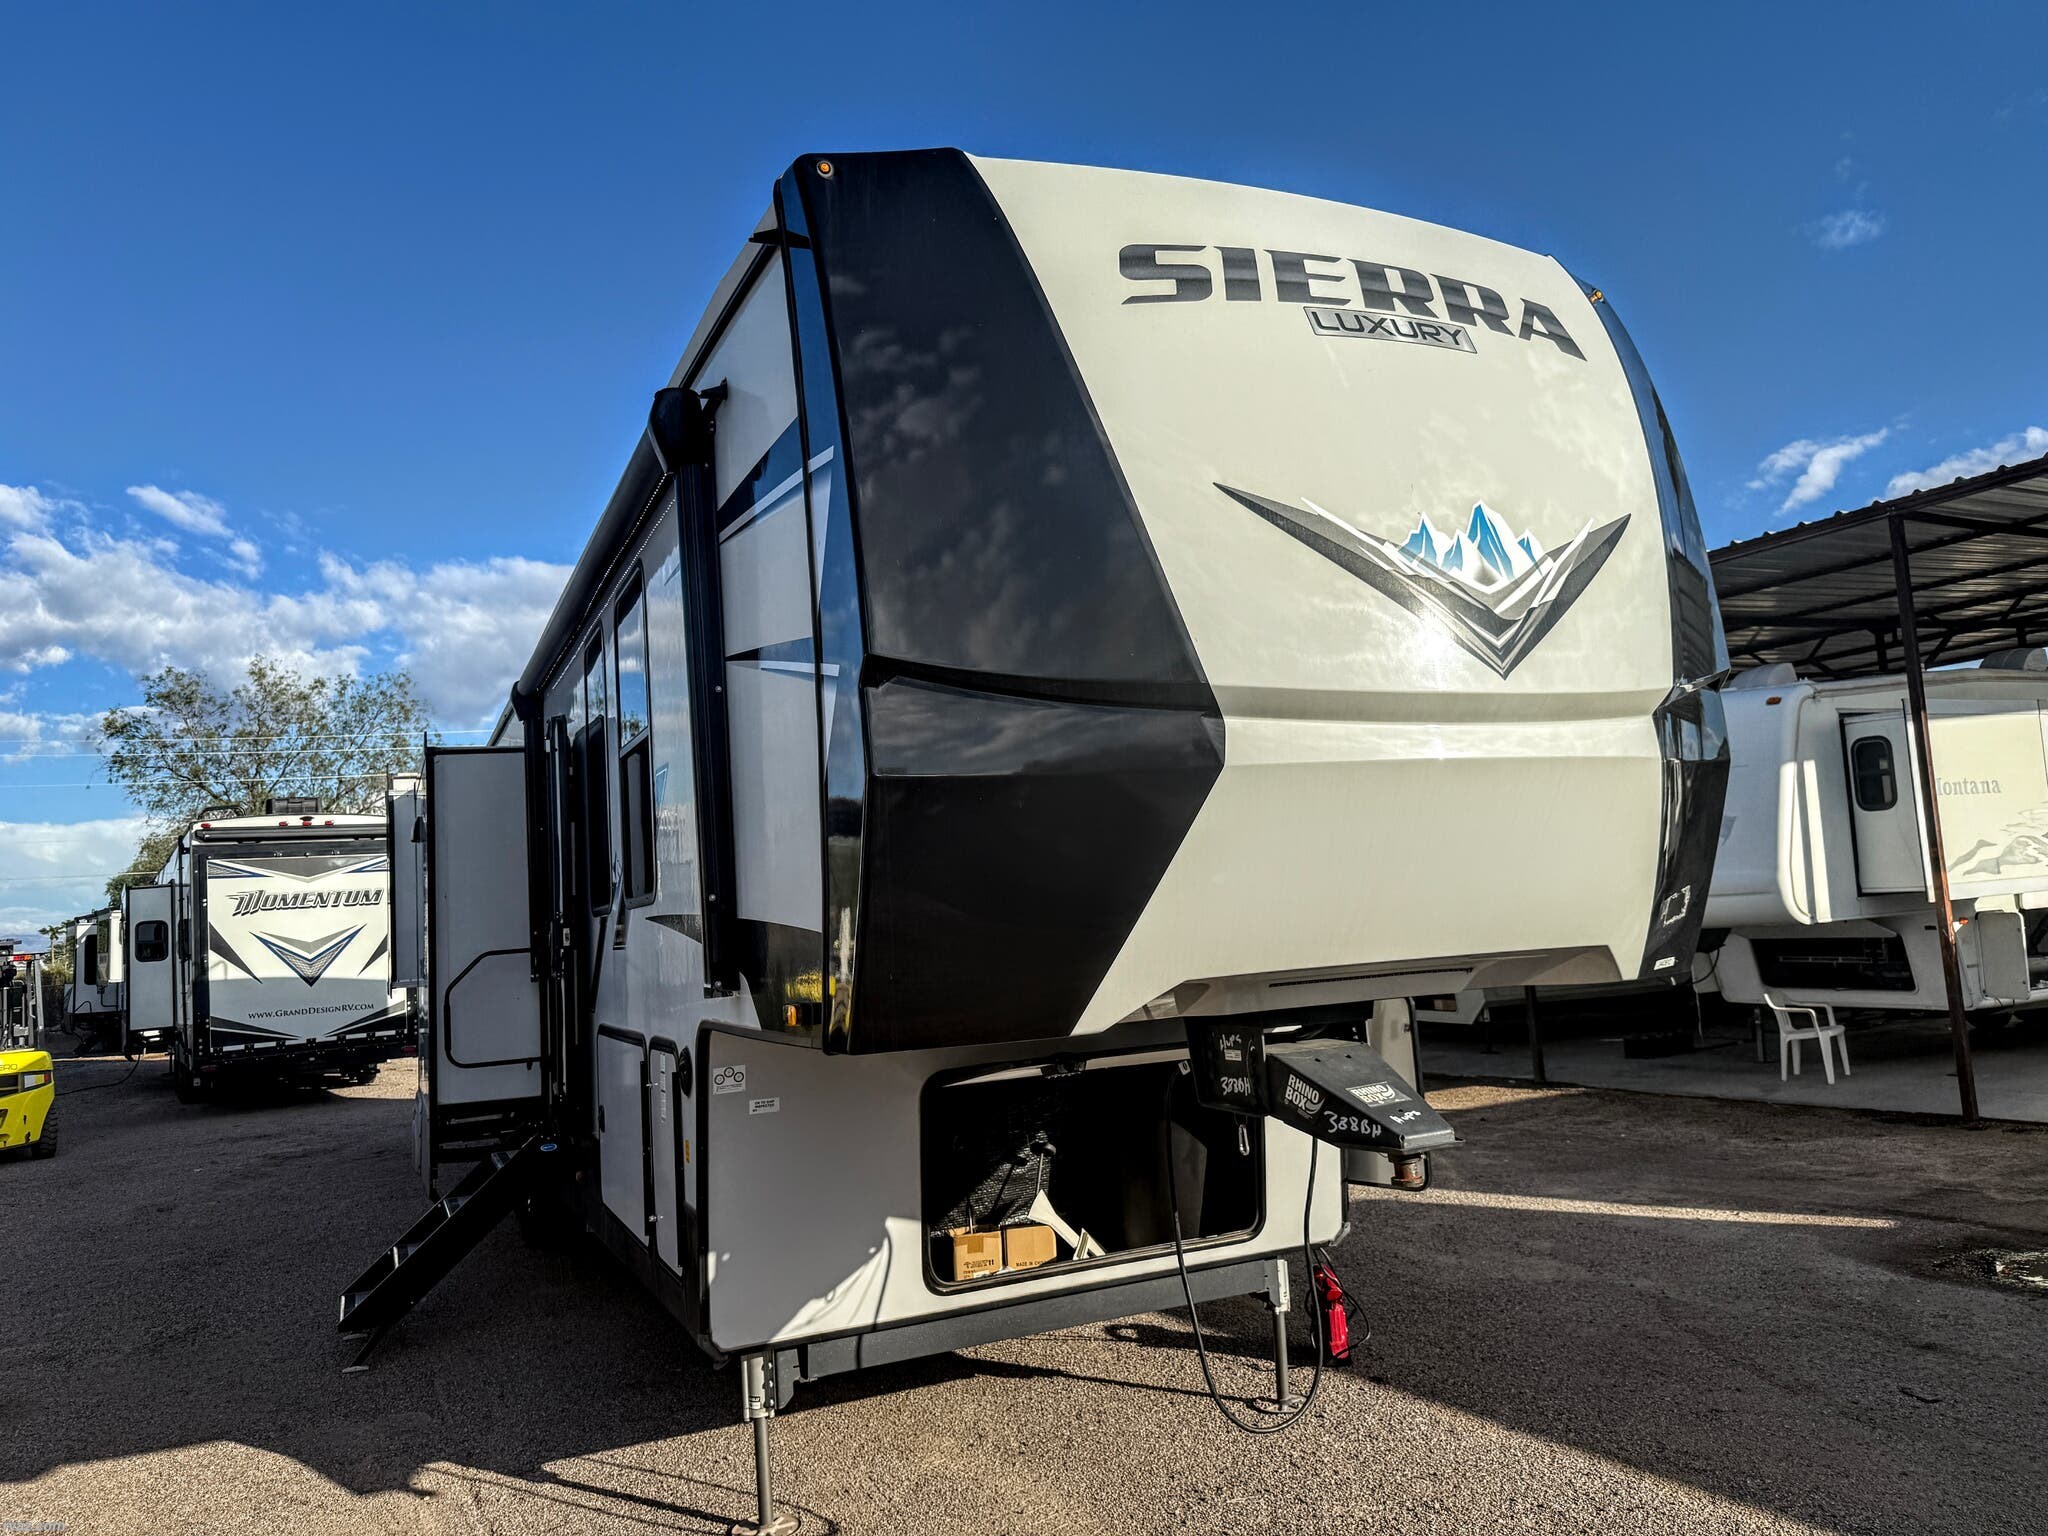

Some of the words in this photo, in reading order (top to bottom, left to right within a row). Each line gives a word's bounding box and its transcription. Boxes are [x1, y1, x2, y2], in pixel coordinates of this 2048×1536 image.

[1118, 243, 1587, 361] SIERRA
[1311, 311, 1466, 346] LUXURY
[230, 888, 384, 917] MOMENTUM
[1285, 1085, 1308, 1110] BOX
[1288, 1073, 1320, 1103] RHINO
[1350, 1084, 1387, 1097] RHINO
[1359, 1092, 1387, 1103] BOX
[1324, 1110, 1382, 1138] 388BH
